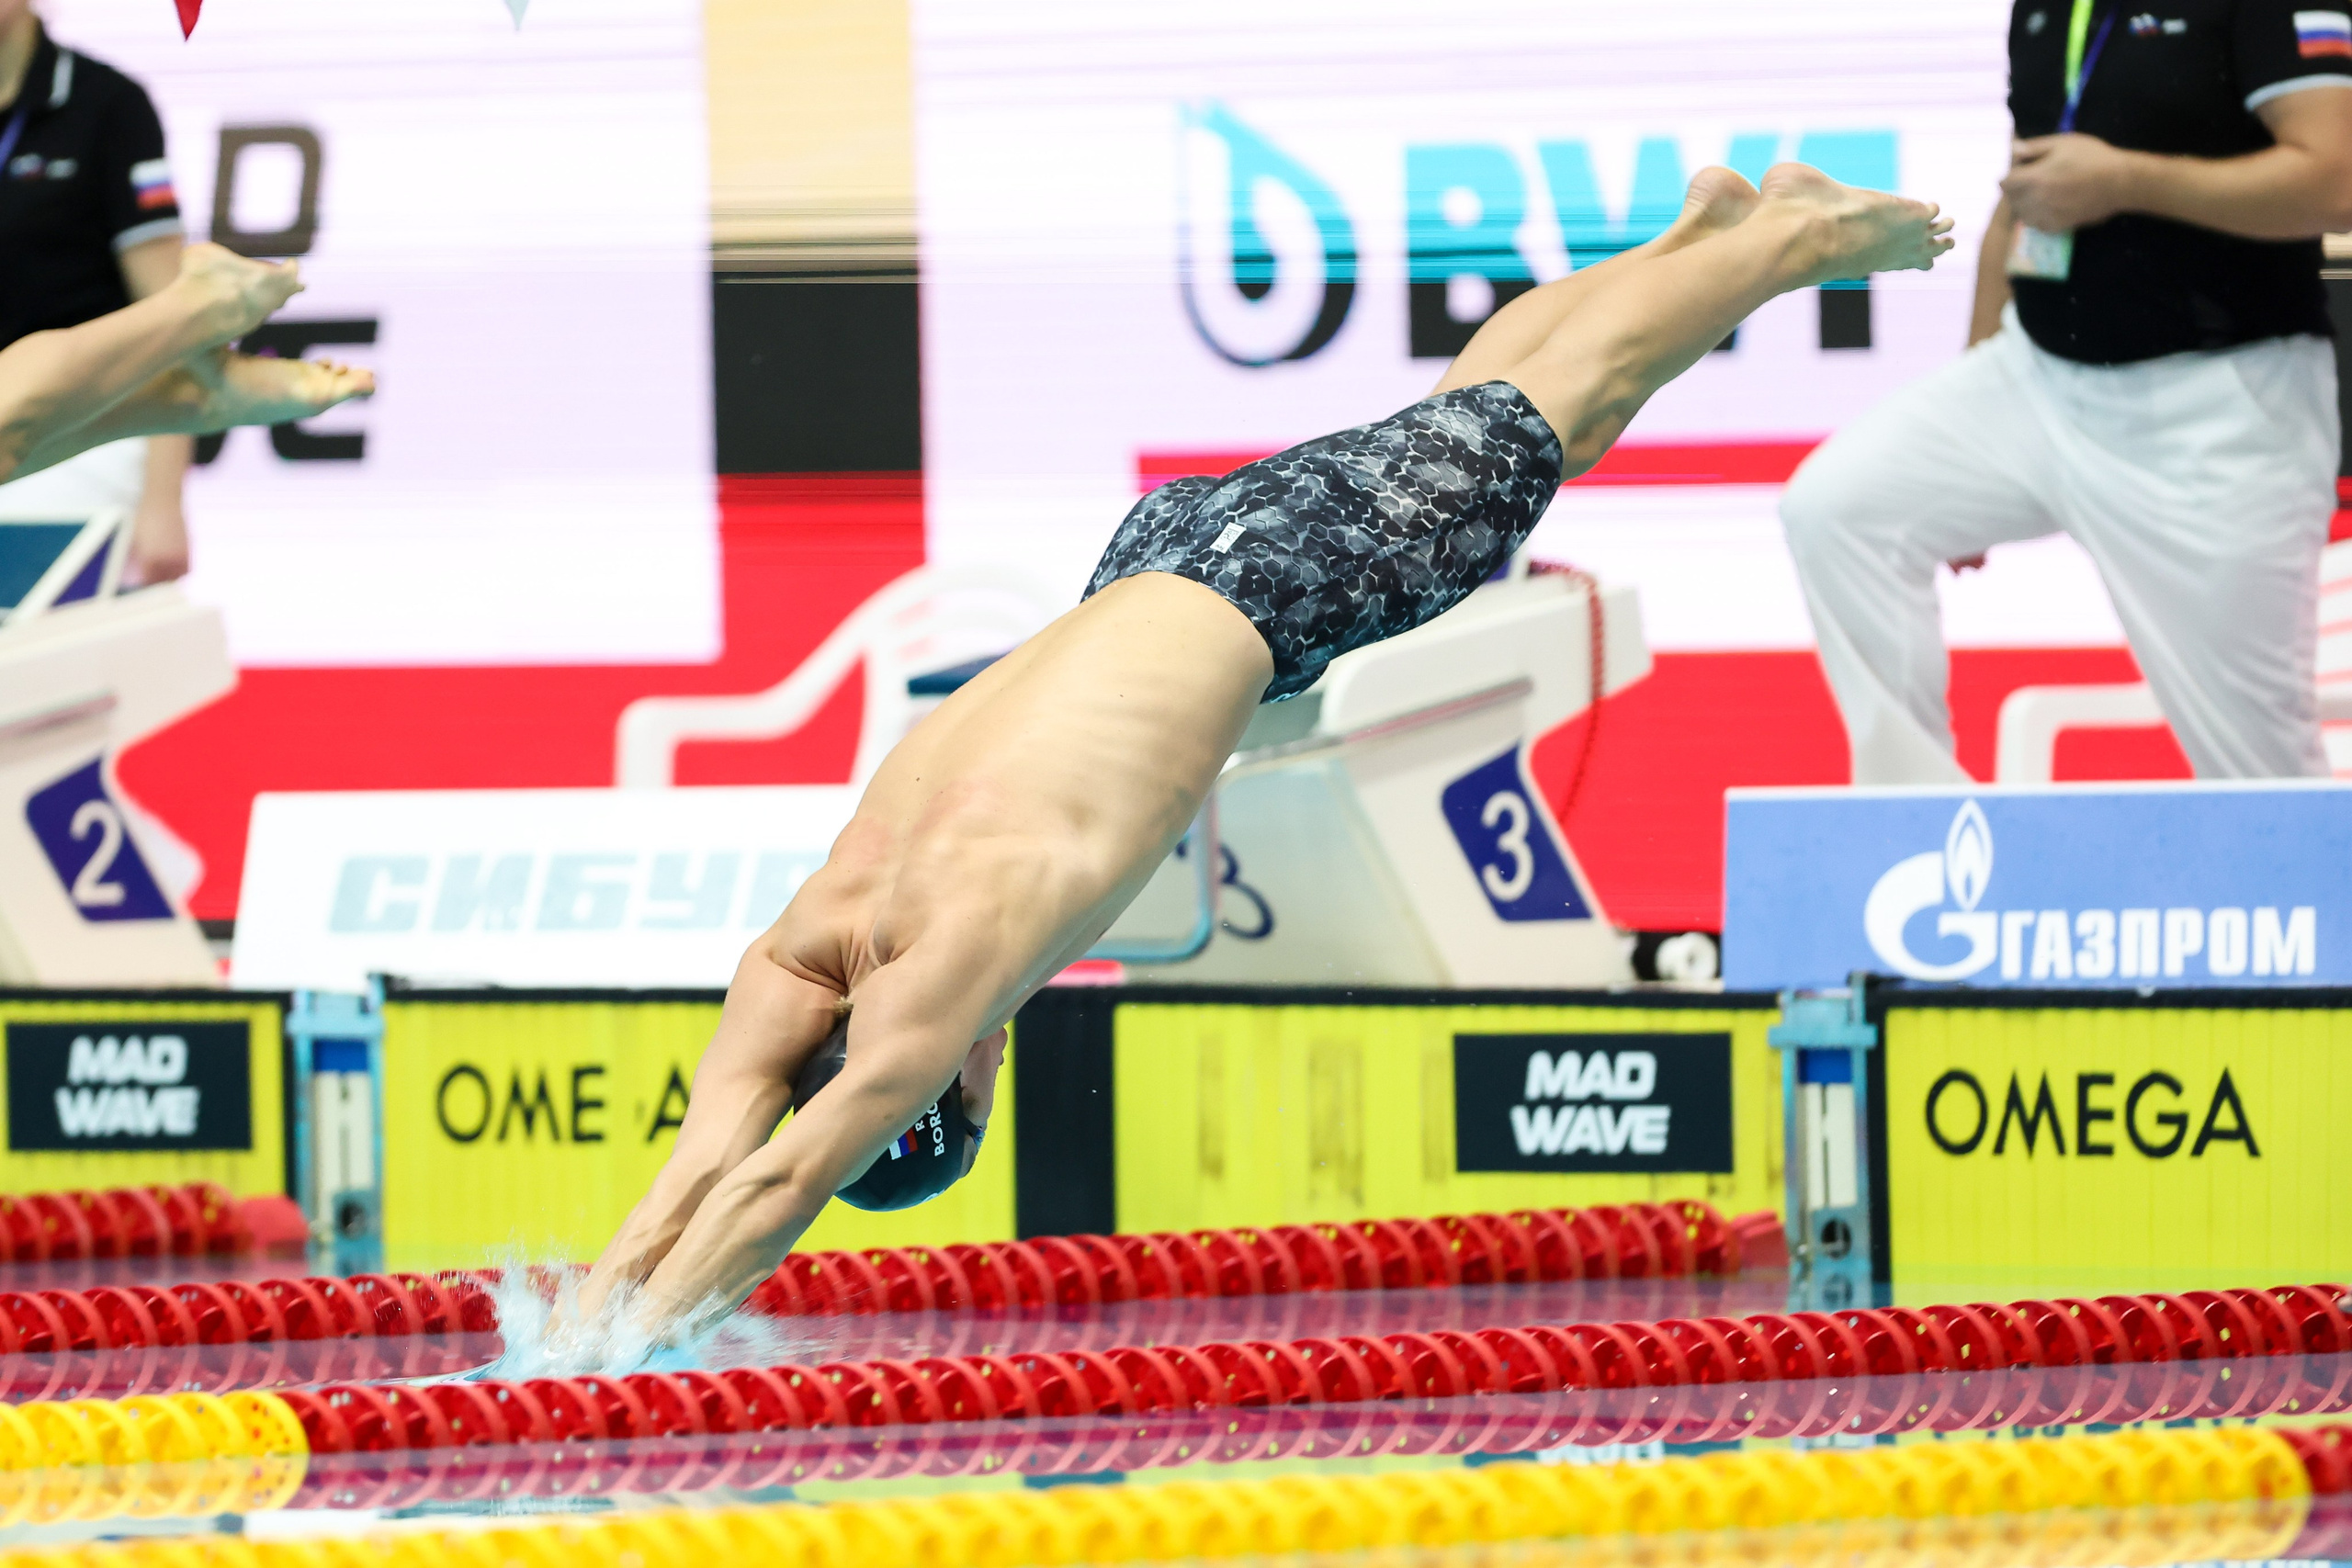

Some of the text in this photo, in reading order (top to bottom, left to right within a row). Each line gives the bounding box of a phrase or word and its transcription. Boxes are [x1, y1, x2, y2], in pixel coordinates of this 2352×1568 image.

[69, 800, 126, 907] 2
[1482, 791, 1534, 902] 3
[2000, 906, 2317, 980] ГАЗПРОМ
[67, 1034, 188, 1086] MAD
[1525, 1051, 1656, 1101] MAD
[54, 1086, 201, 1138] WAVE
[1510, 1105, 1671, 1156] WAVE
[1925, 1067, 2262, 1160] OMEGA
